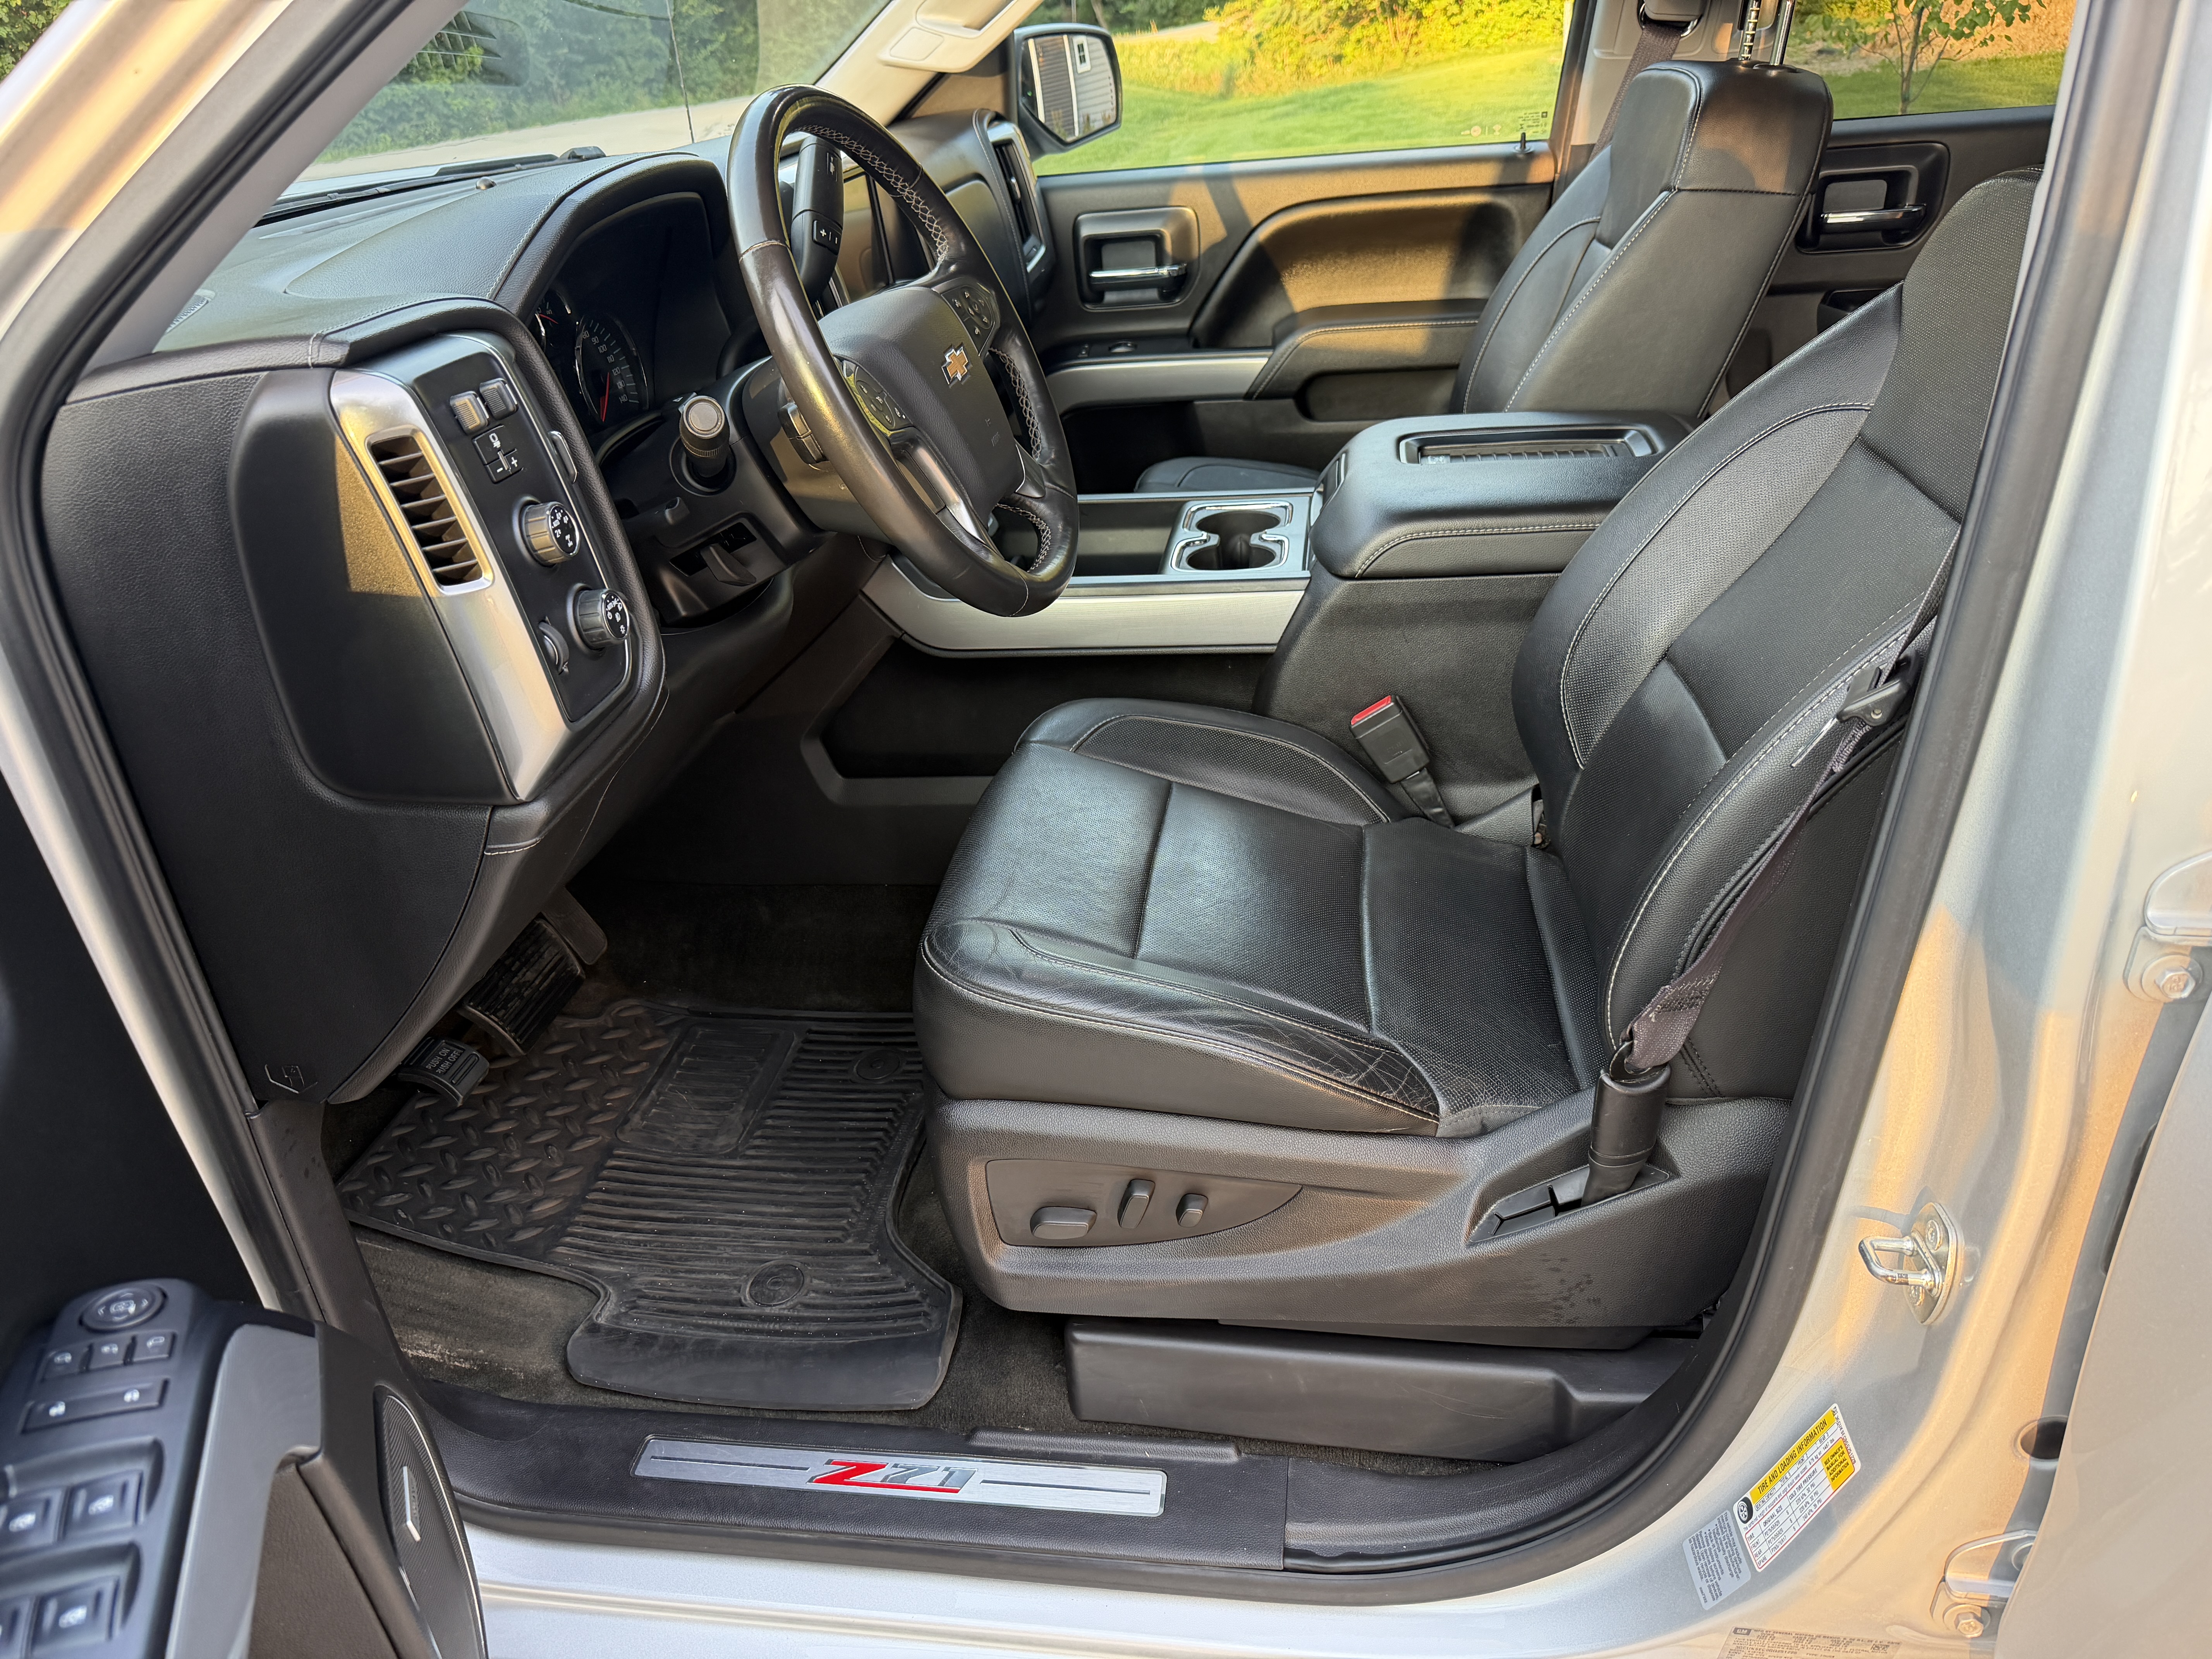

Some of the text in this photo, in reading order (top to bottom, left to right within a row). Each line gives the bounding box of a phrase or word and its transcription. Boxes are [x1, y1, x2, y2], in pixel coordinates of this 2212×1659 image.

[591, 336, 599, 345] 90
[598, 344, 607, 354] 100
[606, 354, 615, 364] 110
[612, 366, 621, 376] 120
[616, 380, 625, 390] 130
[619, 394, 628, 404] 140
[439, 1048, 450, 1056] ON
[448, 1050, 460, 1061] OFF
[1757, 1418, 1827, 1495] TIRE AND LOADING INFORMATION
[1829, 1444, 1843, 1460] OWNER'S
[1797, 1456, 1805, 1467] FRONT
[1826, 1456, 1839, 1471] MANUAL
[1828, 1455, 1847, 1477] ADDITIONAL
[805, 1459, 978, 1493] Z71
[1830, 1460, 1849, 1482] INFORMATION
[1788, 1489, 1796, 1500] COLD
[1802, 1467, 1817, 1486] PRESSURE
[1716, 1517, 1725, 1535] installed
[1762, 1510, 1776, 1528] ORIGINAL
[1711, 1528, 1722, 1553] headlamps
[1718, 1515, 1742, 1574] mercury-containing devices
[1725, 1521, 1734, 1537] vehicle
[1734, 1546, 1743, 1565] include
[1750, 1538, 1760, 1551] FRONT
[1689, 1543, 1700, 1566] hazardous
[1713, 1548, 1724, 1575] instruments
[1717, 1536, 1727, 1556] intensity
[1724, 1555, 1735, 1578] discharge
[1754, 1547, 1762, 1559] REAR
[1757, 1554, 1767, 1567] SPARE
[1697, 1530, 1706, 1549] Remove
[1703, 1547, 1712, 1566] devices
[1714, 1579, 1723, 1597] vehicle
[1703, 1560, 1712, 1578] removal
[1707, 1546, 1716, 1563] display
[1713, 1562, 1721, 1581] screens
[1699, 1562, 1707, 1579] recycle
[1707, 1583, 1716, 1602] dispose
